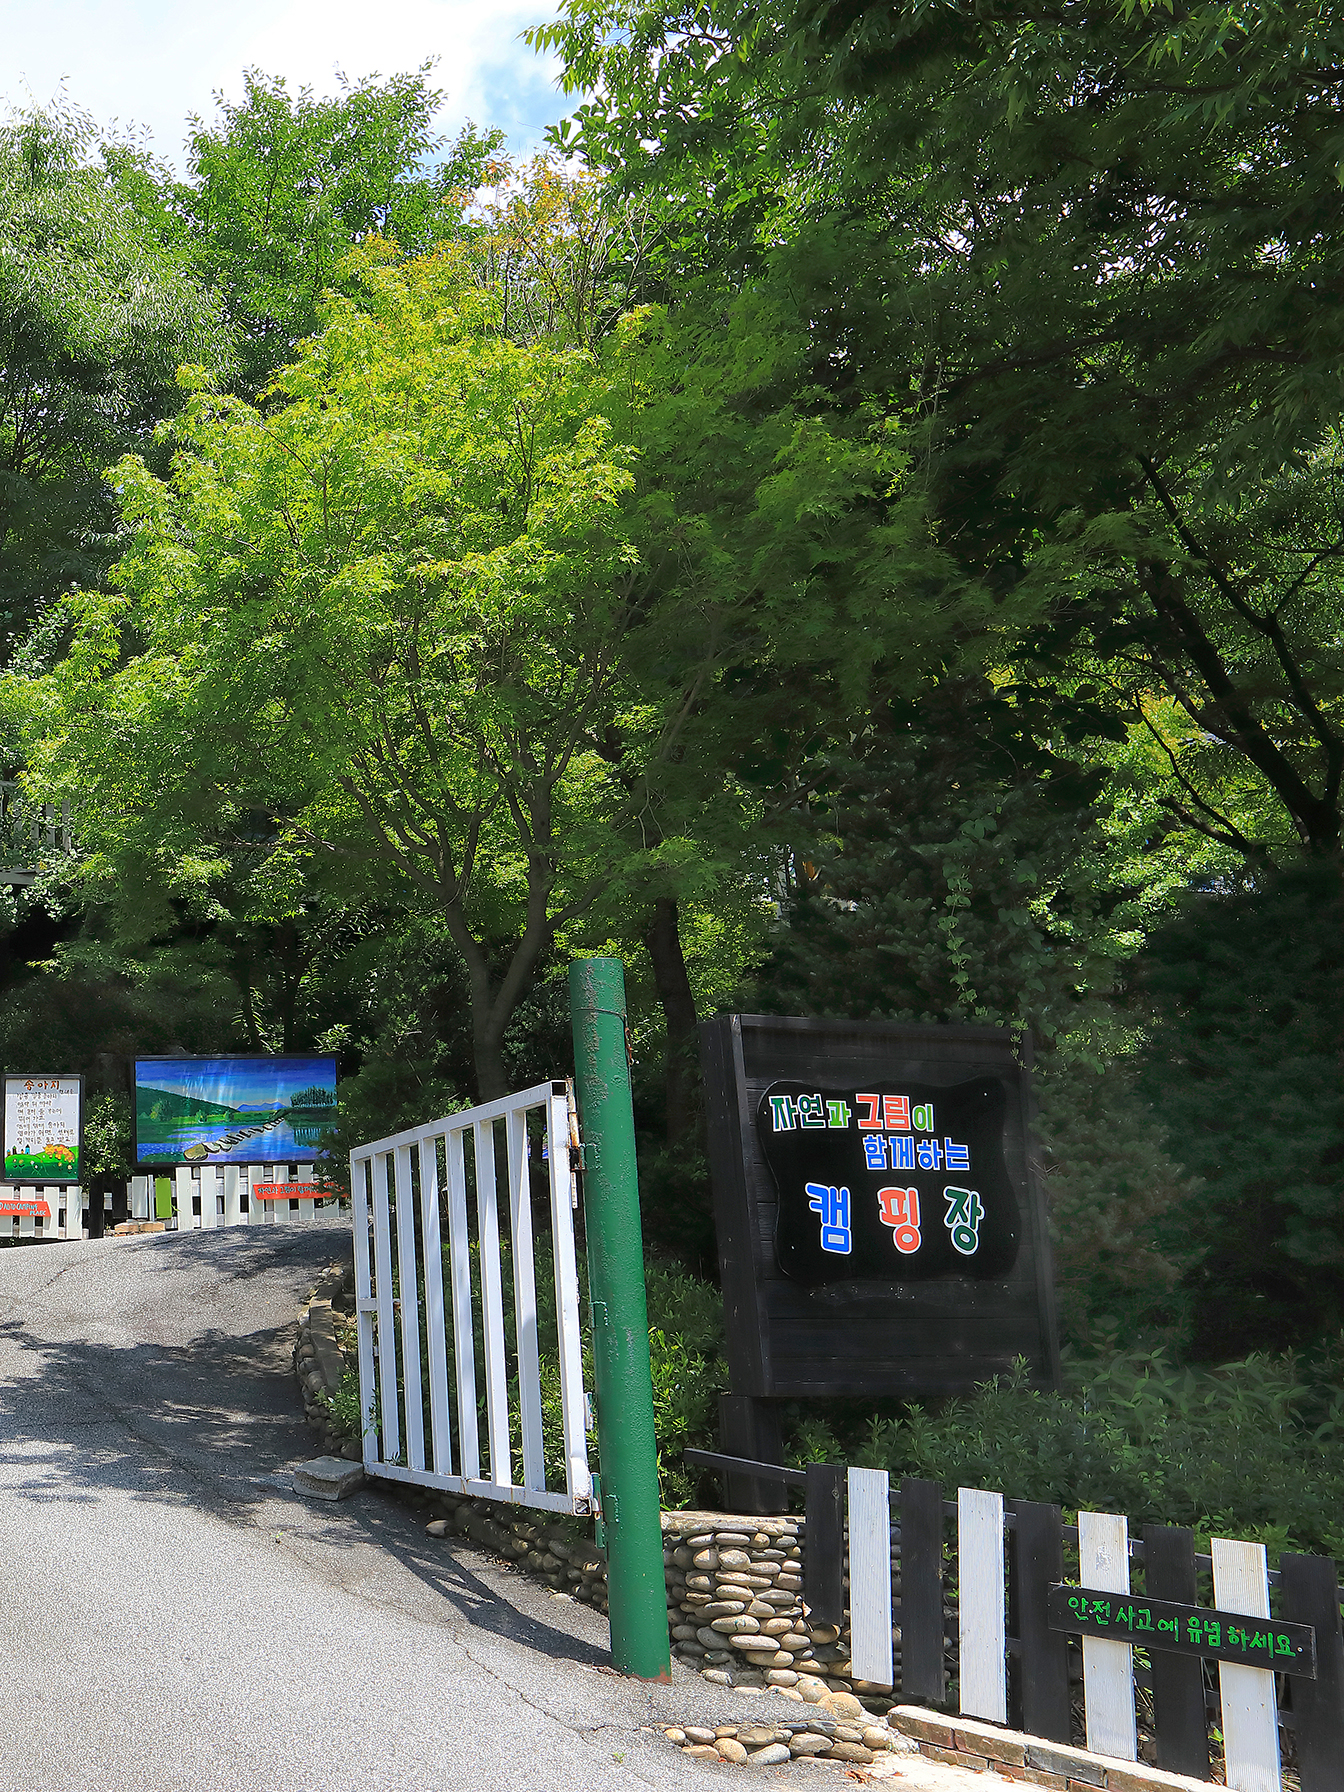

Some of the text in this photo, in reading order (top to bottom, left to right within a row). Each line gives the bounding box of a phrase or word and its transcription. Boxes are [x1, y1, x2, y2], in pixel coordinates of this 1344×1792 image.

[24, 1080, 60, 1091] 송아지
[769, 1093, 935, 1132] 자연과 그림이
[862, 1134, 971, 1171] 함께하는
[805, 1182, 985, 1255] 캠핑장
